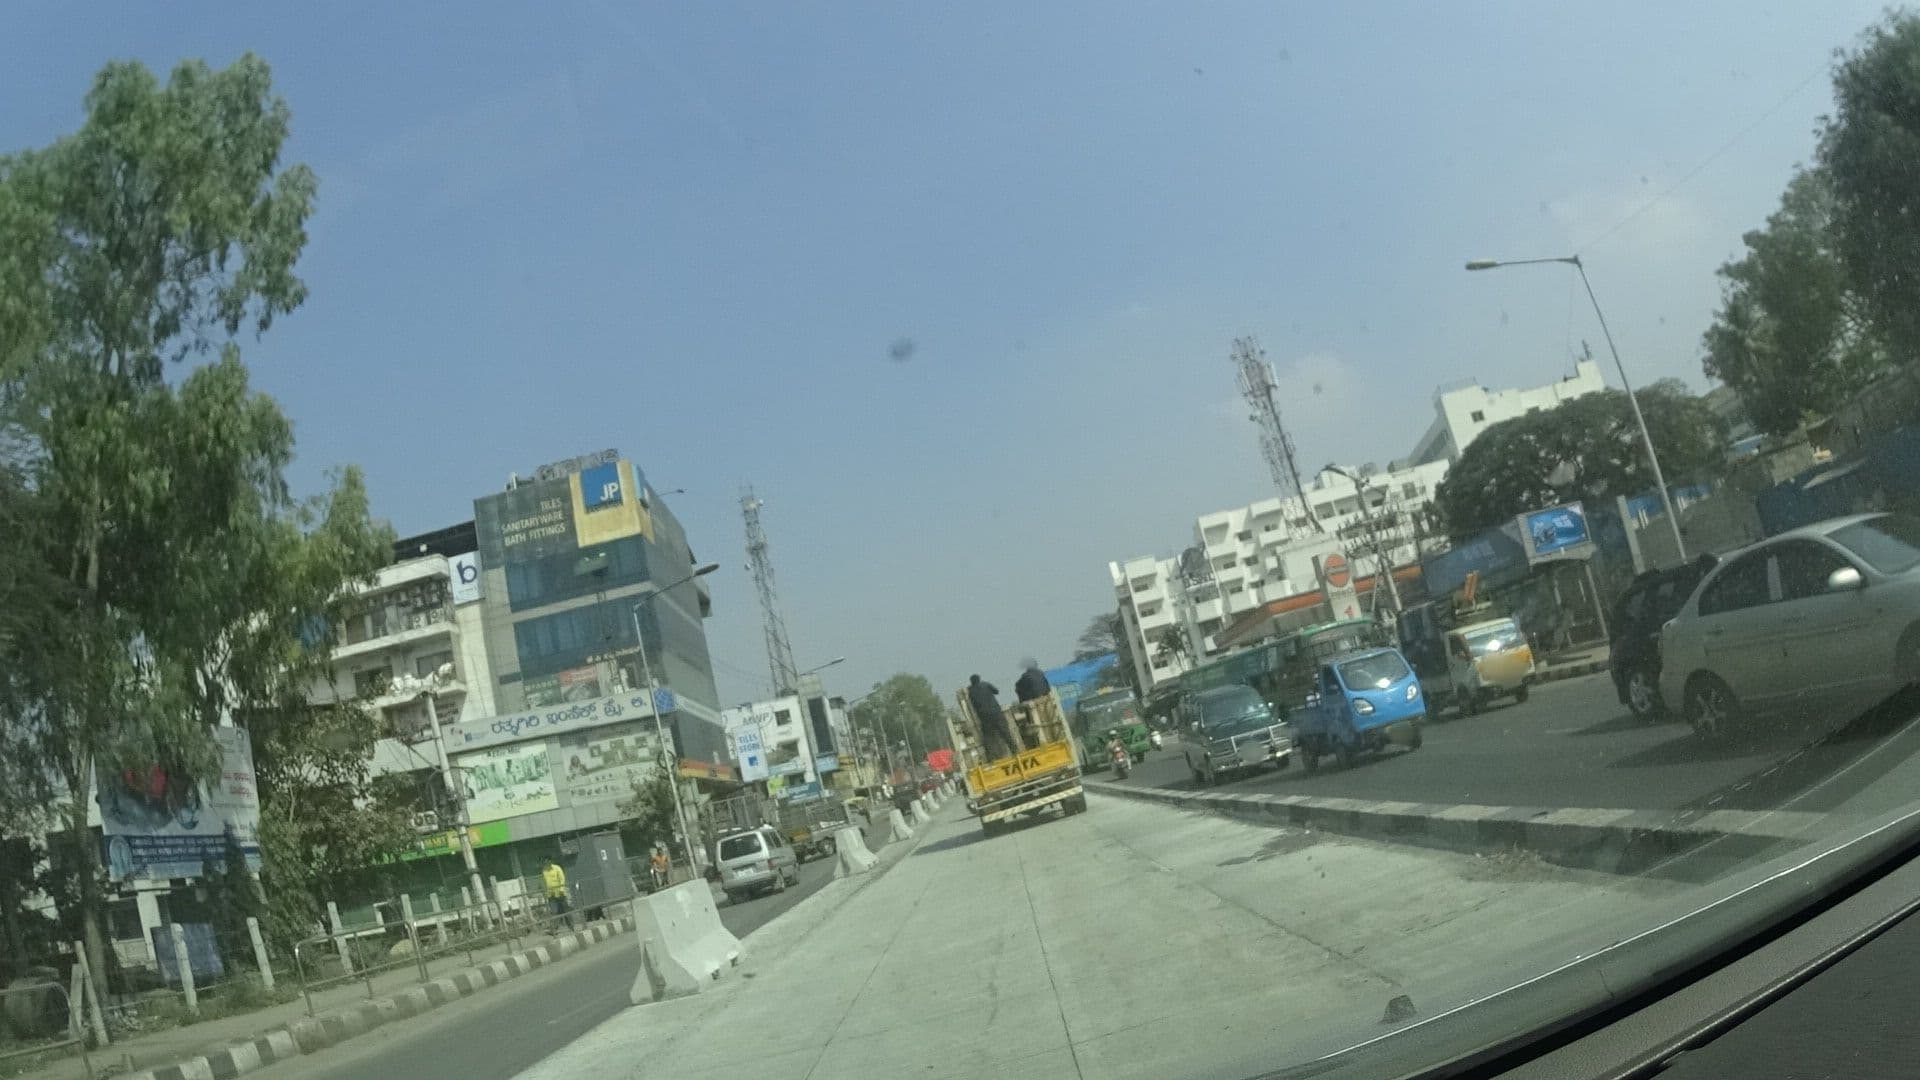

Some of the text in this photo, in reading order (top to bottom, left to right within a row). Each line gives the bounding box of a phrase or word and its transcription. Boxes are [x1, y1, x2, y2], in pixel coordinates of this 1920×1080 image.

[600, 482, 619, 501] JP
[541, 497, 563, 511] TILES
[503, 523, 566, 547] BATH FITTINGS
[738, 733, 758, 744] TILES
[738, 742, 762, 754] STORE
[1001, 757, 1041, 776] TATA
